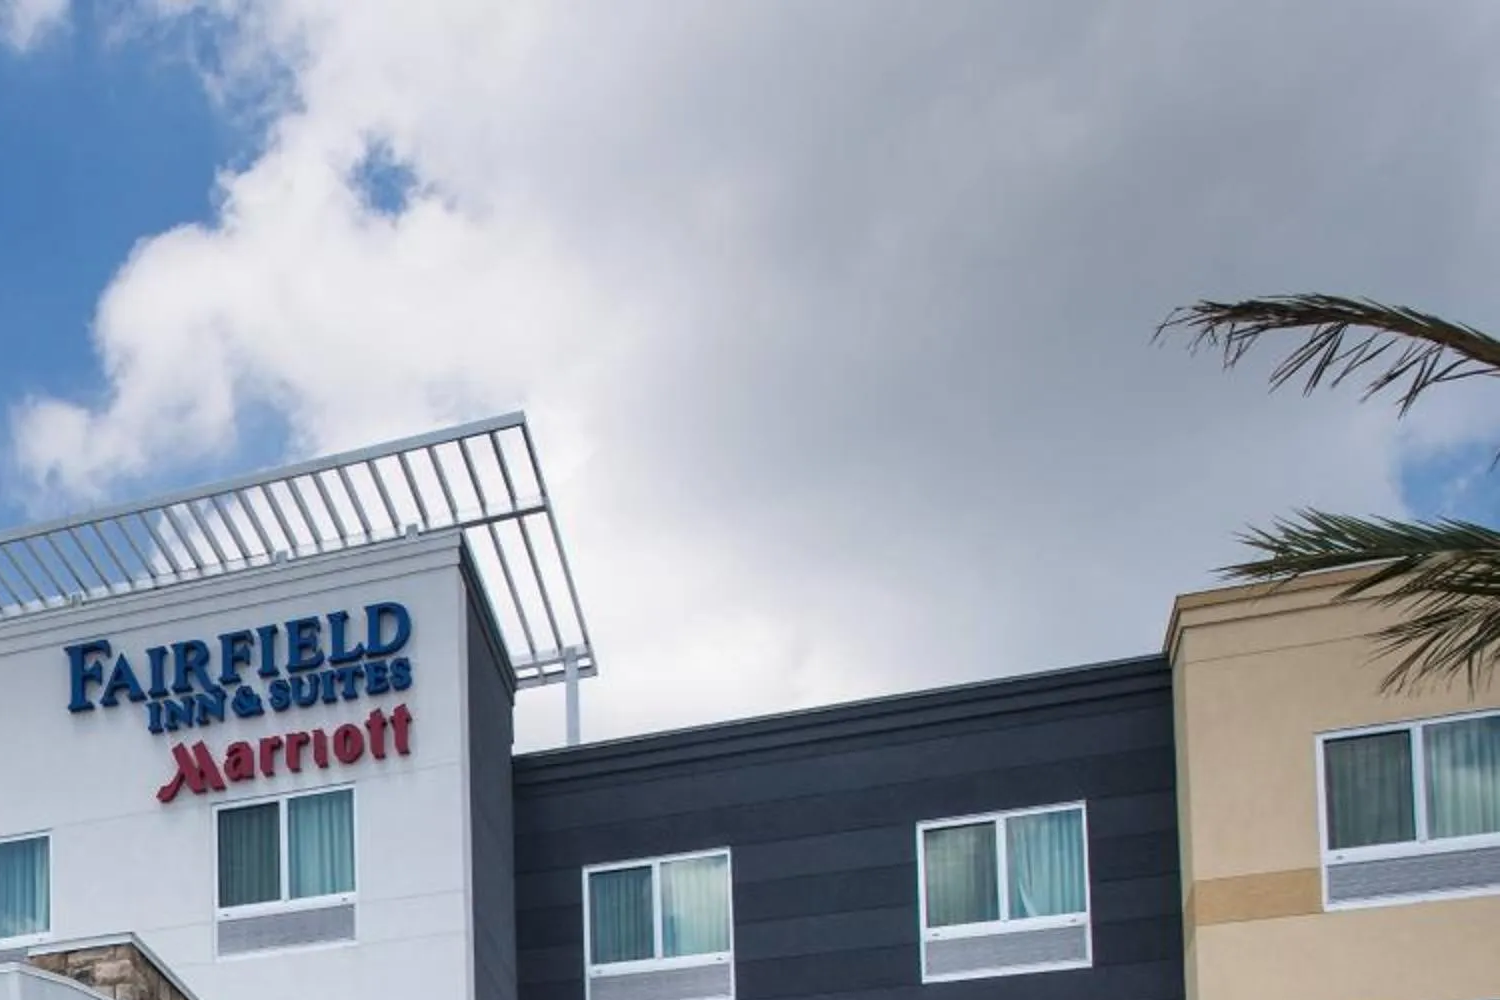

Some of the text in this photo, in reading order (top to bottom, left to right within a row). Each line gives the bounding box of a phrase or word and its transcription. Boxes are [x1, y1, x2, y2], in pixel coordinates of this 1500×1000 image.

[63, 601, 412, 713] FAIRFIELD
[146, 692, 226, 734] INN
[268, 657, 413, 712] SUITES
[156, 703, 412, 803] Marriott
